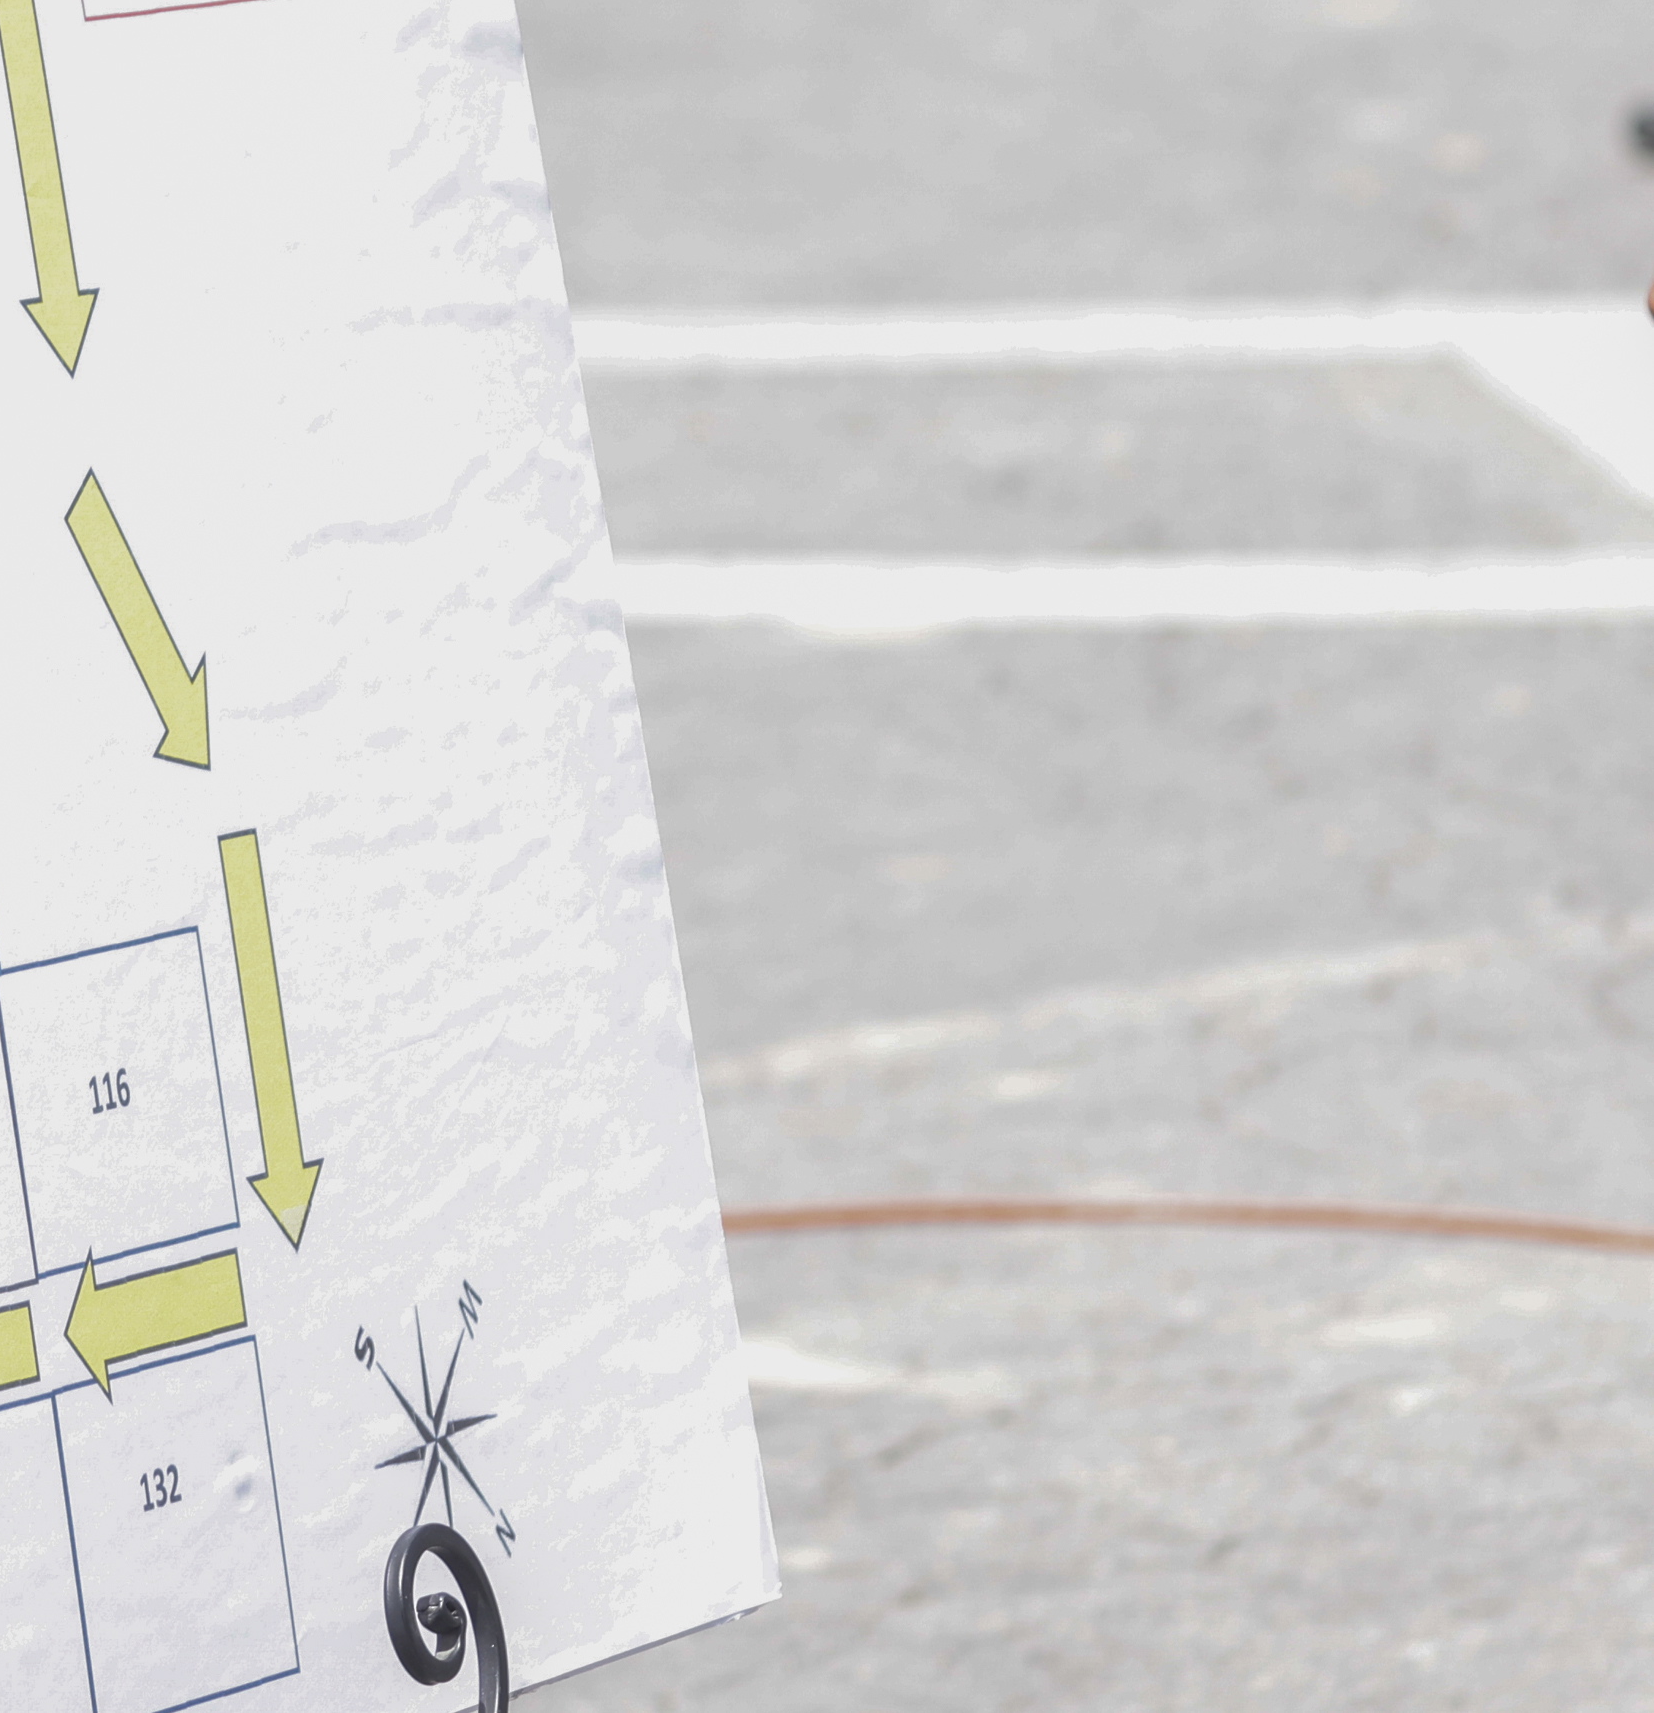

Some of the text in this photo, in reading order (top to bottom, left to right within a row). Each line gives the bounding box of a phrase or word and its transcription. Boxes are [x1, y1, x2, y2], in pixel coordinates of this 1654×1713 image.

[87, 1066, 132, 1116] 116
[352, 1324, 377, 1373] S
[138, 1462, 184, 1514] 132
